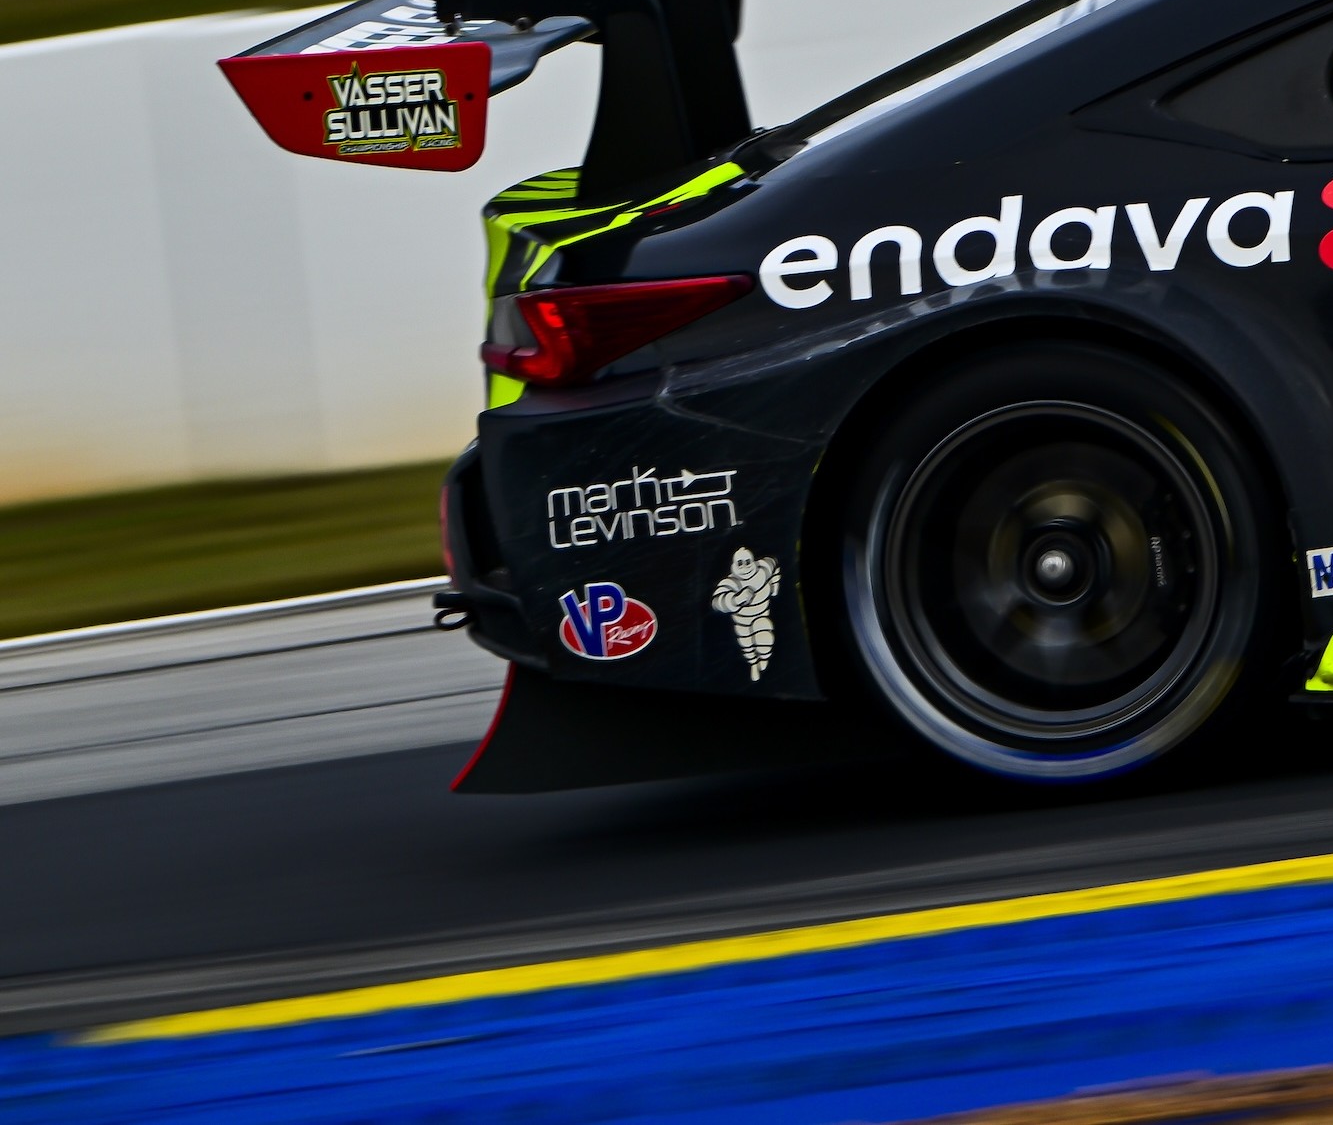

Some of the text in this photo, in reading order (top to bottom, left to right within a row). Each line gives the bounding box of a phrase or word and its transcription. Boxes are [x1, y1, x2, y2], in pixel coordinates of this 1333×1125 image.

[333, 73, 444, 106] VASSER
[327, 104, 456, 141] SULLIVAN
[758, 190, 1295, 309] endava
[547, 465, 662, 517] mark
[559, 581, 626, 657] VP
[607, 620, 656, 649] Racing
